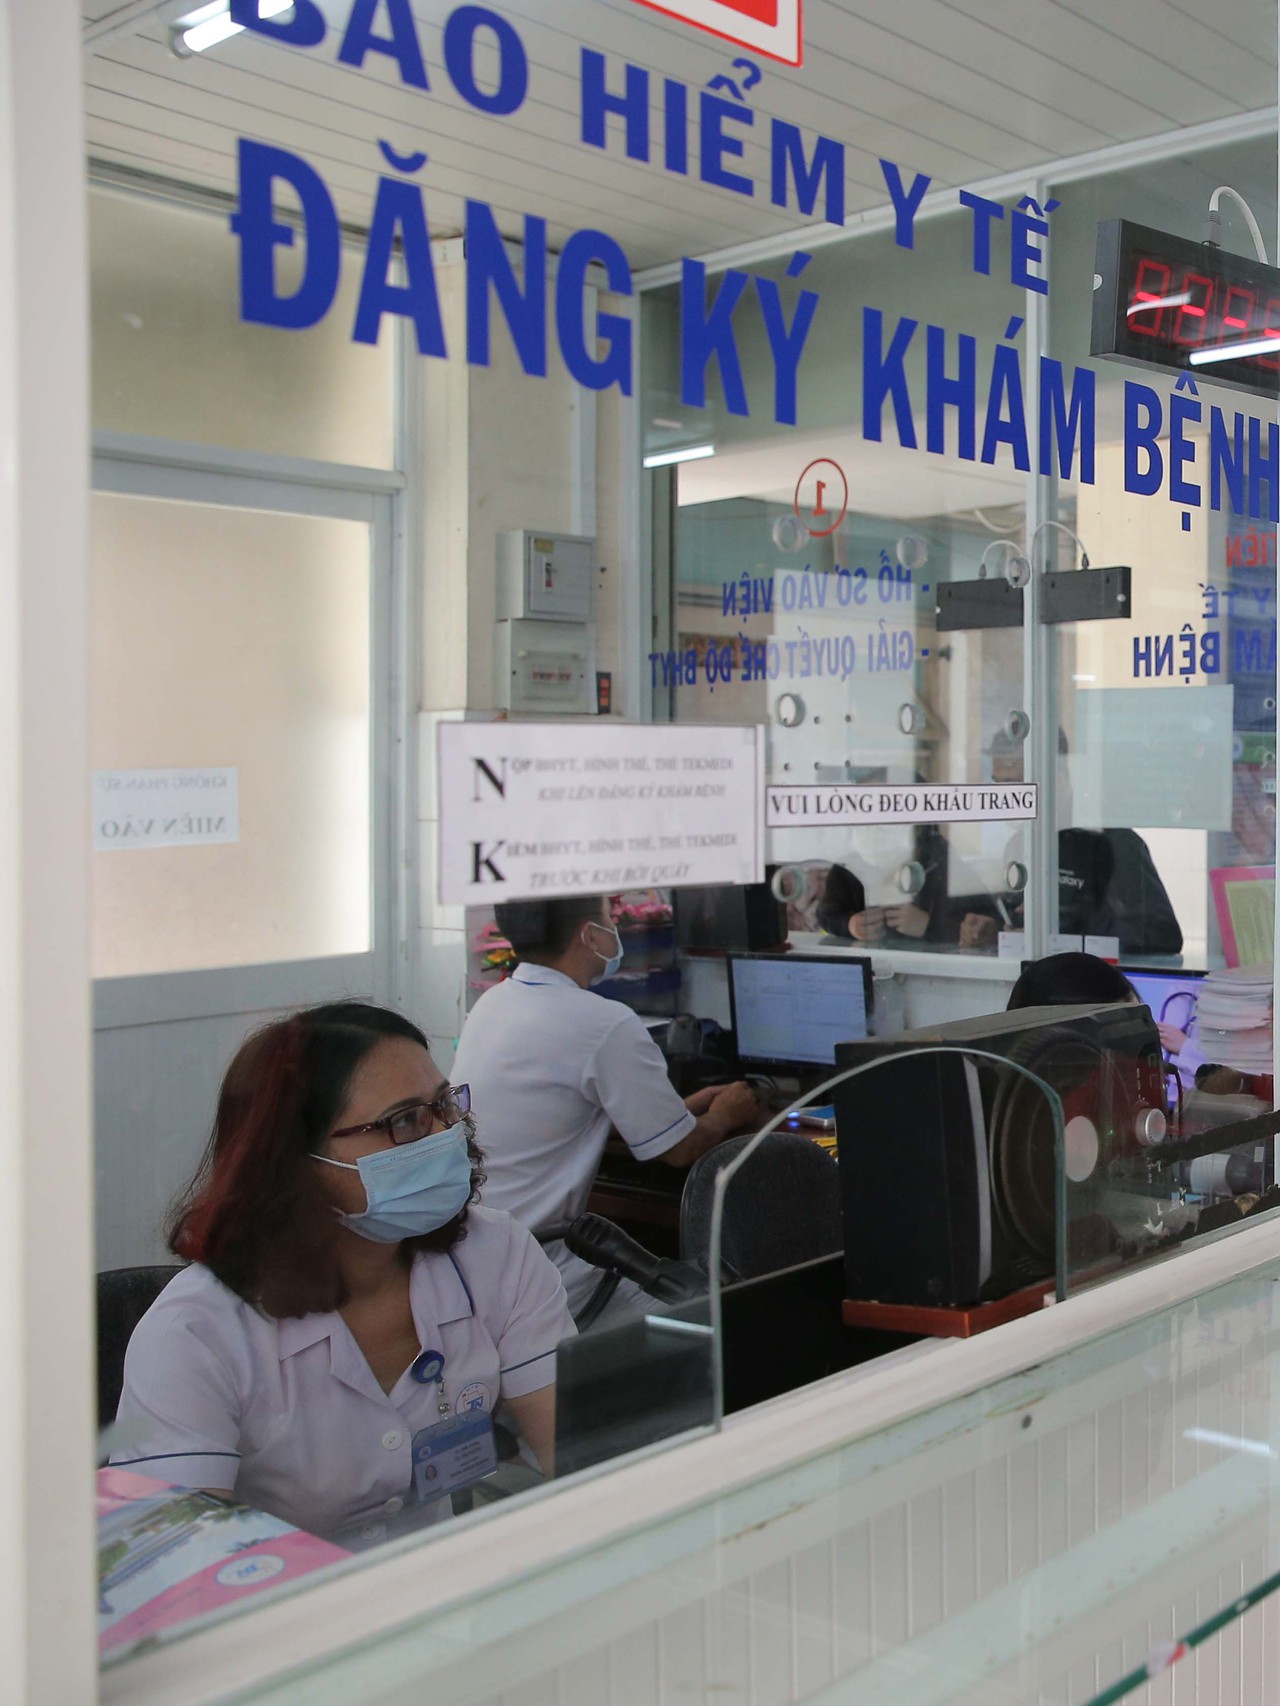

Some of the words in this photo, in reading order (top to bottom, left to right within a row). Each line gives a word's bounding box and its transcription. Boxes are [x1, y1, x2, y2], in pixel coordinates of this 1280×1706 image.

[580, 46, 845, 227] HIỂM
[878, 157, 932, 250] Y
[958, 188, 1062, 296] TẾ
[229, 136, 633, 398] ĐĂNG
[680, 250, 820, 427] KÝ
[862, 305, 1096, 487] KHÁM
[1123, 369, 1280, 532] BỆNH
[770, 794, 809, 815] VUI
[815, 788, 873, 814] LÒNG
[879, 792, 918, 813] ĐEO
[978, 791, 1034, 811] TRANG
